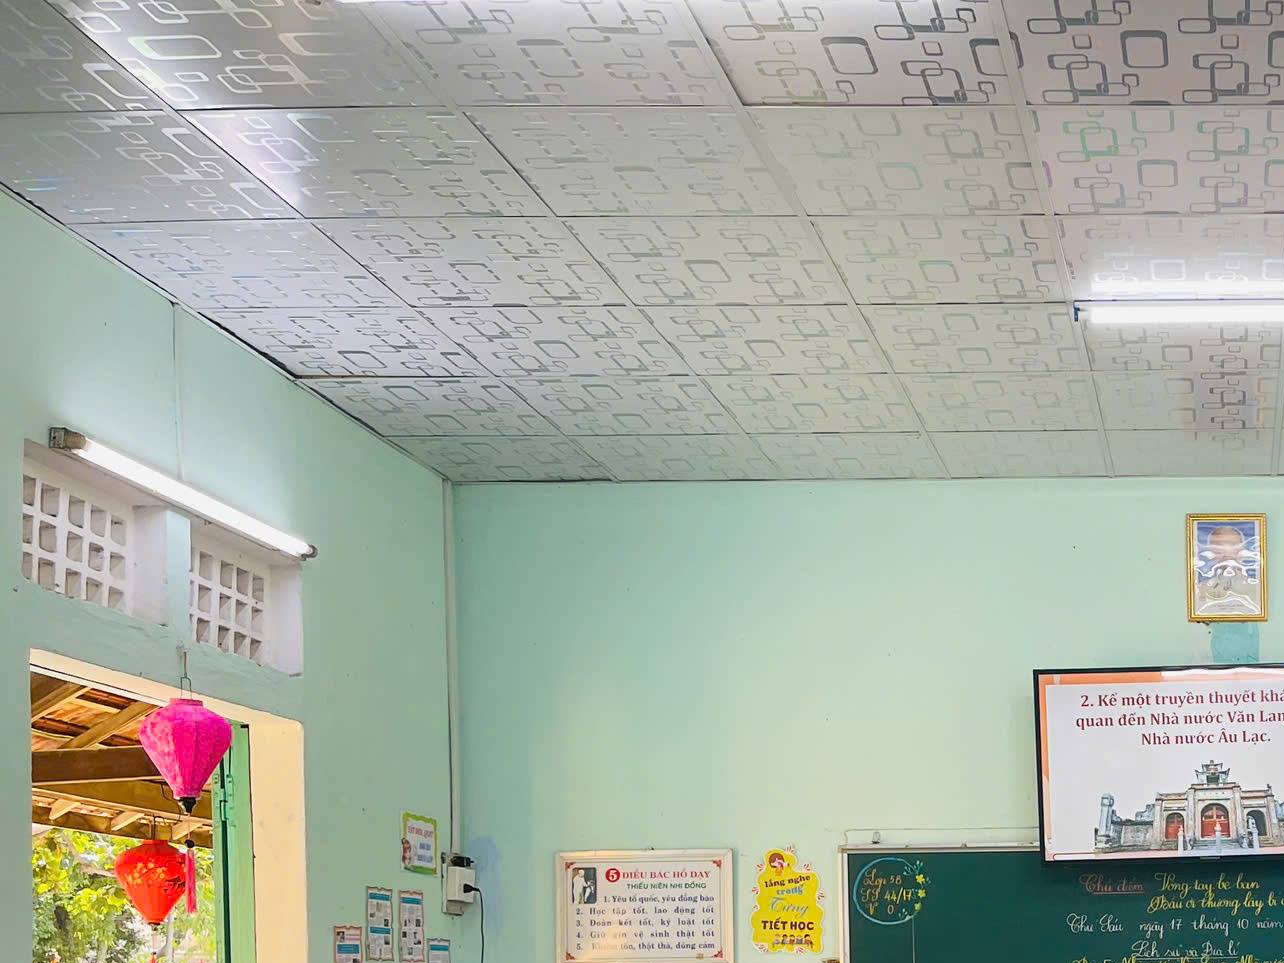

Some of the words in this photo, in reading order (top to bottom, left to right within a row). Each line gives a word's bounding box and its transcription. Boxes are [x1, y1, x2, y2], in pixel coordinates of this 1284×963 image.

[1080, 695, 1094, 707] 2.
[1098, 692, 1117, 707] Kể
[1122, 694, 1151, 709] một
[1155, 691, 1205, 709] truyền
[1208, 689, 1256, 708] thuyết
[1075, 715, 1114, 730] quan
[1118, 712, 1146, 726] đến
[1150, 713, 1179, 726] Nhà
[1184, 712, 1223, 724] nước
[1226, 710, 1255, 724] Văn
[1141, 732, 1170, 746] Nhà
[1175, 732, 1215, 745] nước
[1218, 728, 1239, 744] Âu
[1242, 730, 1271, 746] Lạc.
[761, 917, 788, 931] TIẾT
[790, 921, 815, 932] HỌC
[1170, 918, 1183, 930] 17
[1237, 918, 1249, 930] 10
